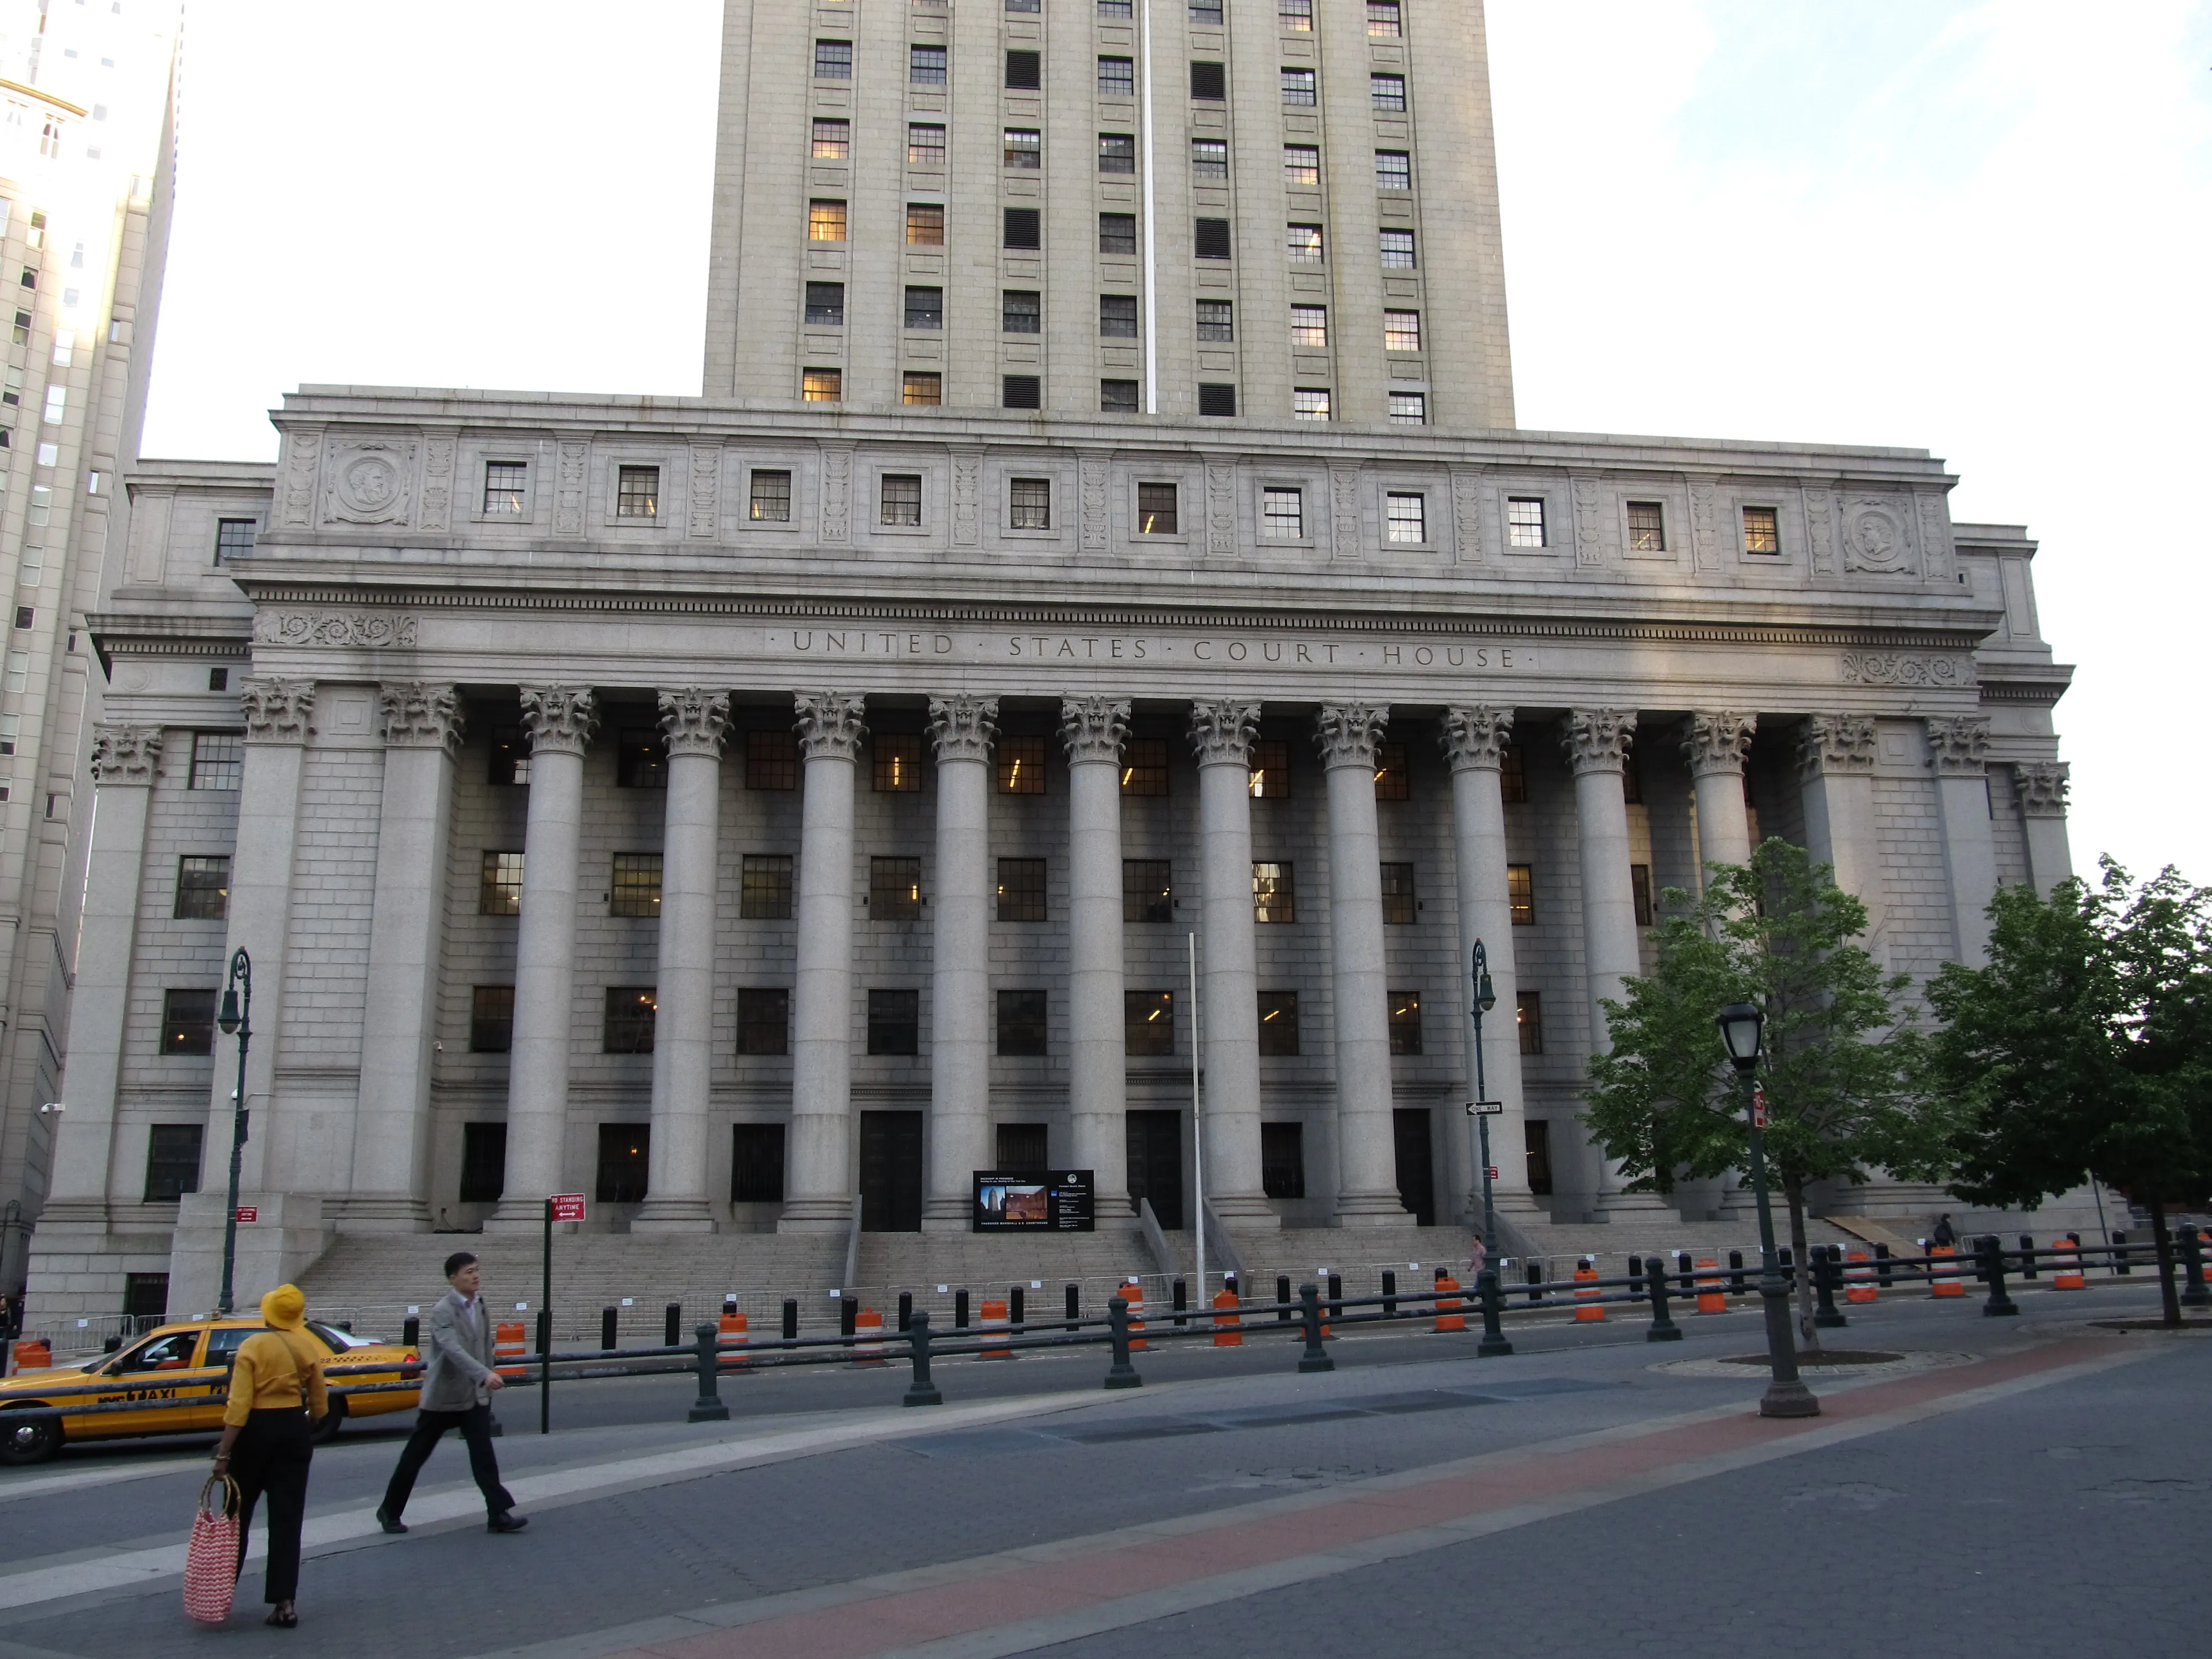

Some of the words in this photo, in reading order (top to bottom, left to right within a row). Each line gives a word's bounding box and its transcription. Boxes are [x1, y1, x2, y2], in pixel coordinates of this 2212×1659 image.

[792, 631, 953, 654] UNITED
[1009, 637, 1147, 658] STATES
[1193, 641, 1339, 663] COURT
[1383, 645, 1513, 667] HOUSE
